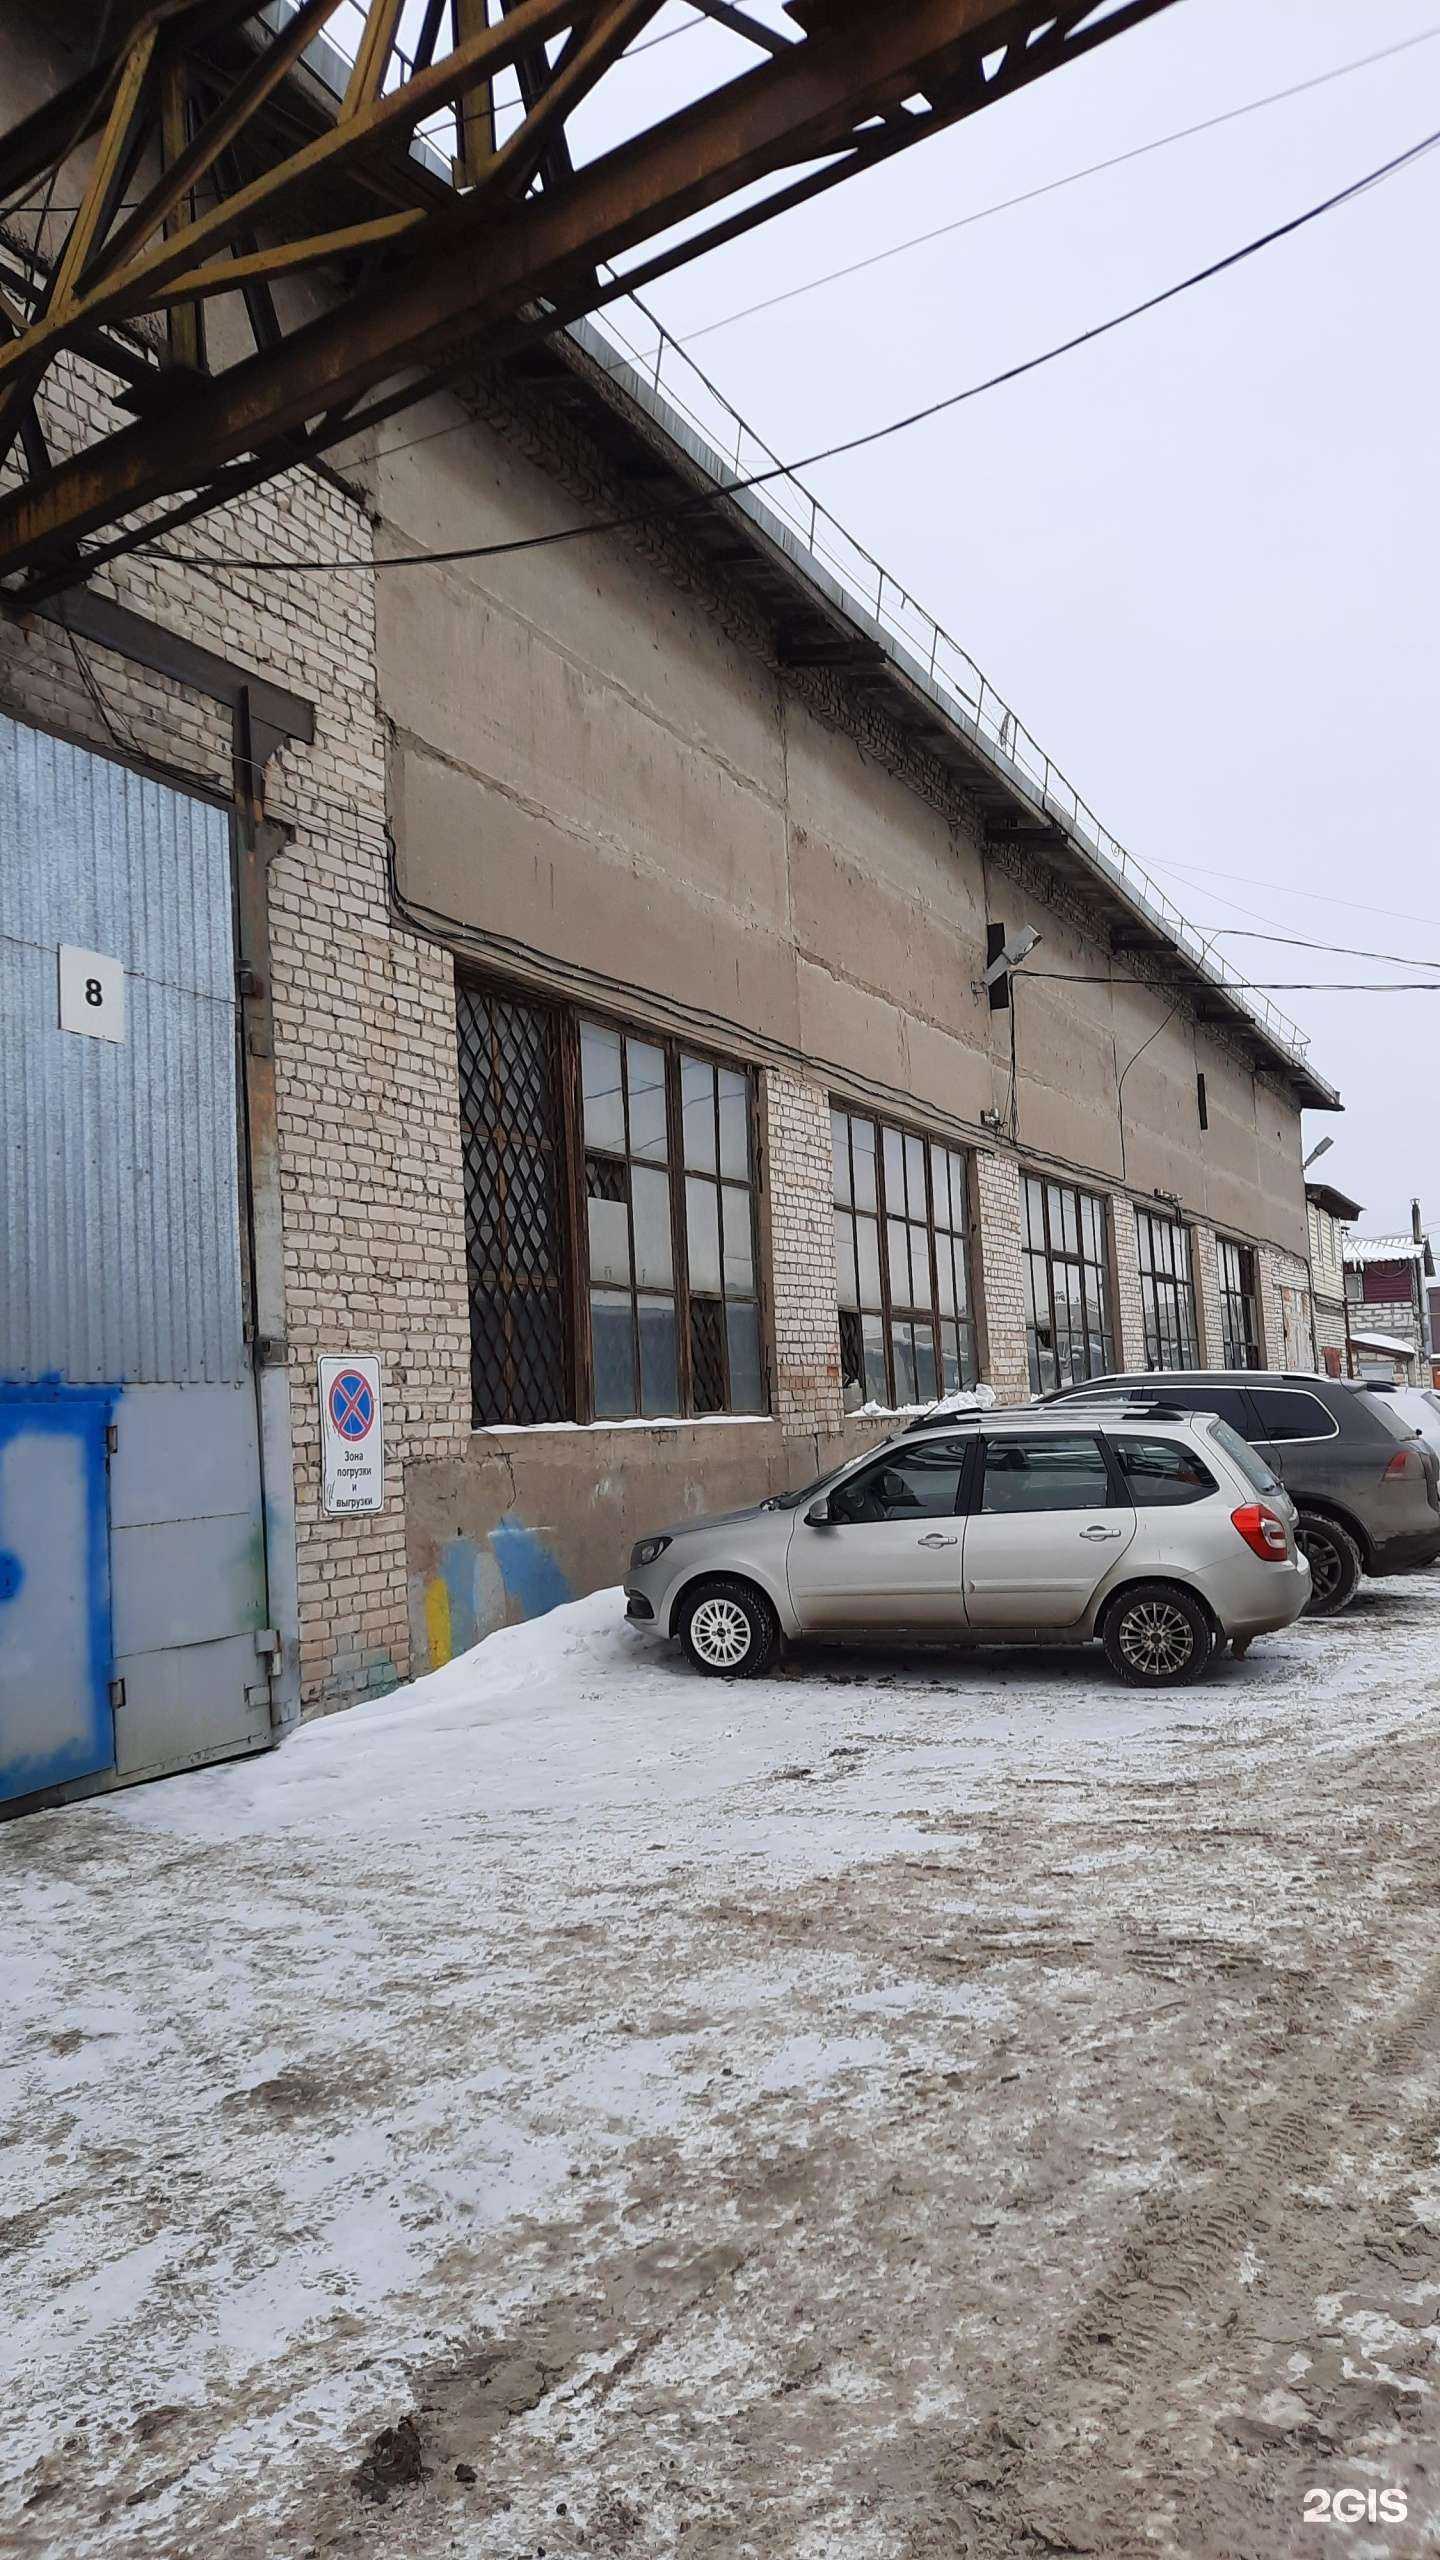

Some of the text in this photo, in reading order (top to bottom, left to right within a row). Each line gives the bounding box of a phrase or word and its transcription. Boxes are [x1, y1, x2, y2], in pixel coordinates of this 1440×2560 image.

[85, 978, 103, 1007] 8
[344, 1450, 364, 1462] Зона
[337, 1467, 372, 1478] погрузки
[352, 1484, 357, 1492] и
[336, 1497, 373, 1509] выгрузки
